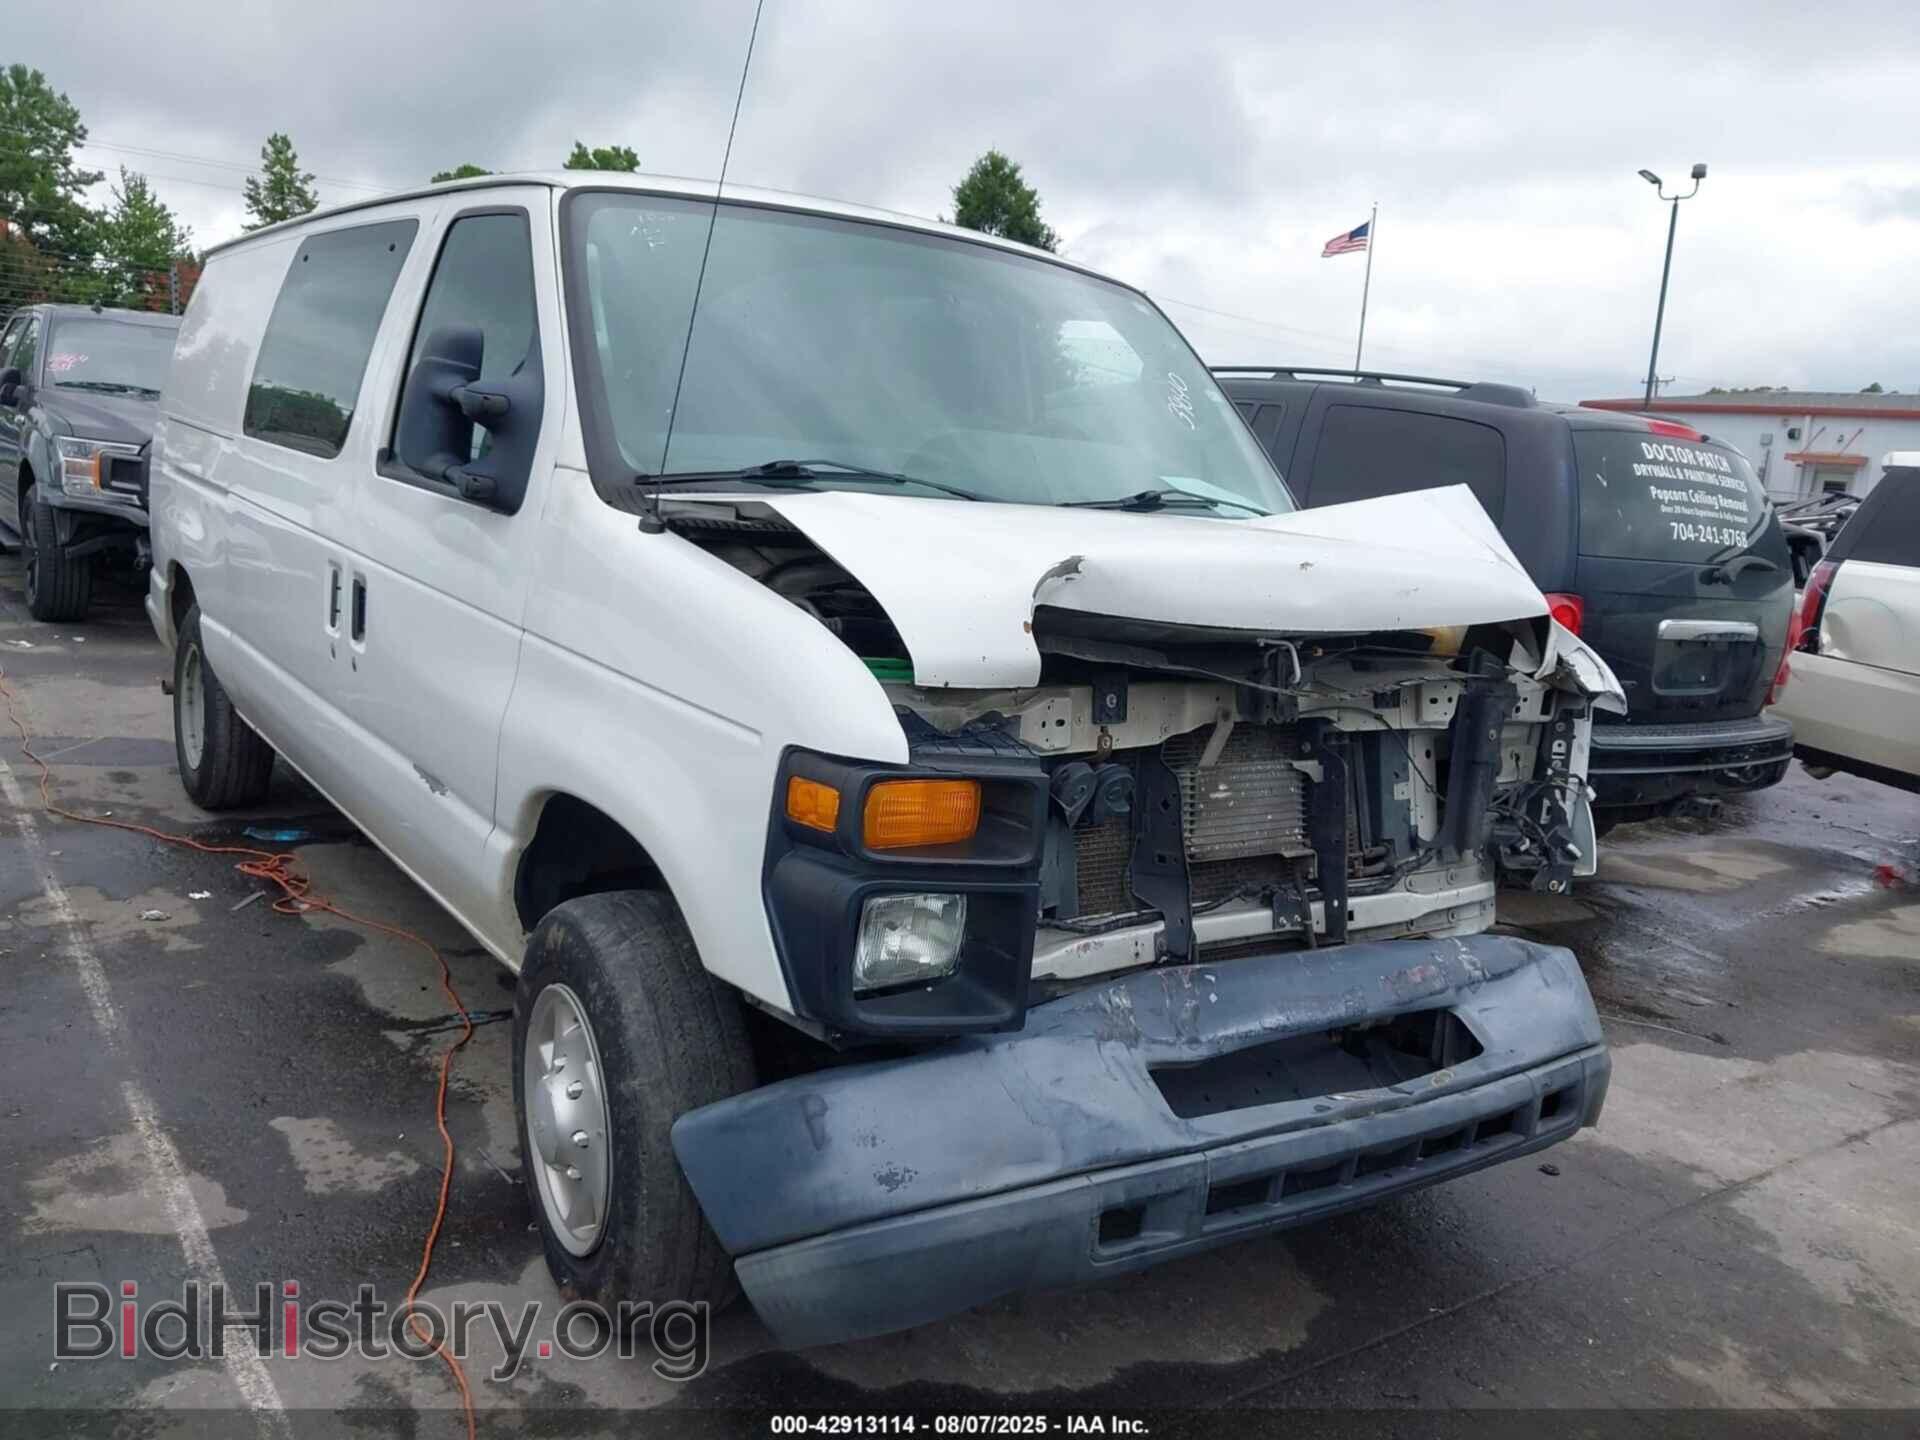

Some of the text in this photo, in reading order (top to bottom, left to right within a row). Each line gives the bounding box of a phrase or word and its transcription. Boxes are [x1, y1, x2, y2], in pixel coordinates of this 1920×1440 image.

[1641, 442, 1731, 473] DOCTOR PATCH
[1633, 463, 1747, 493] DRYWALL & PAINTING SERVICES
[1650, 485, 1748, 512] Popcorn Ceiling Removal
[1670, 522, 1748, 548] 704-241-8768
